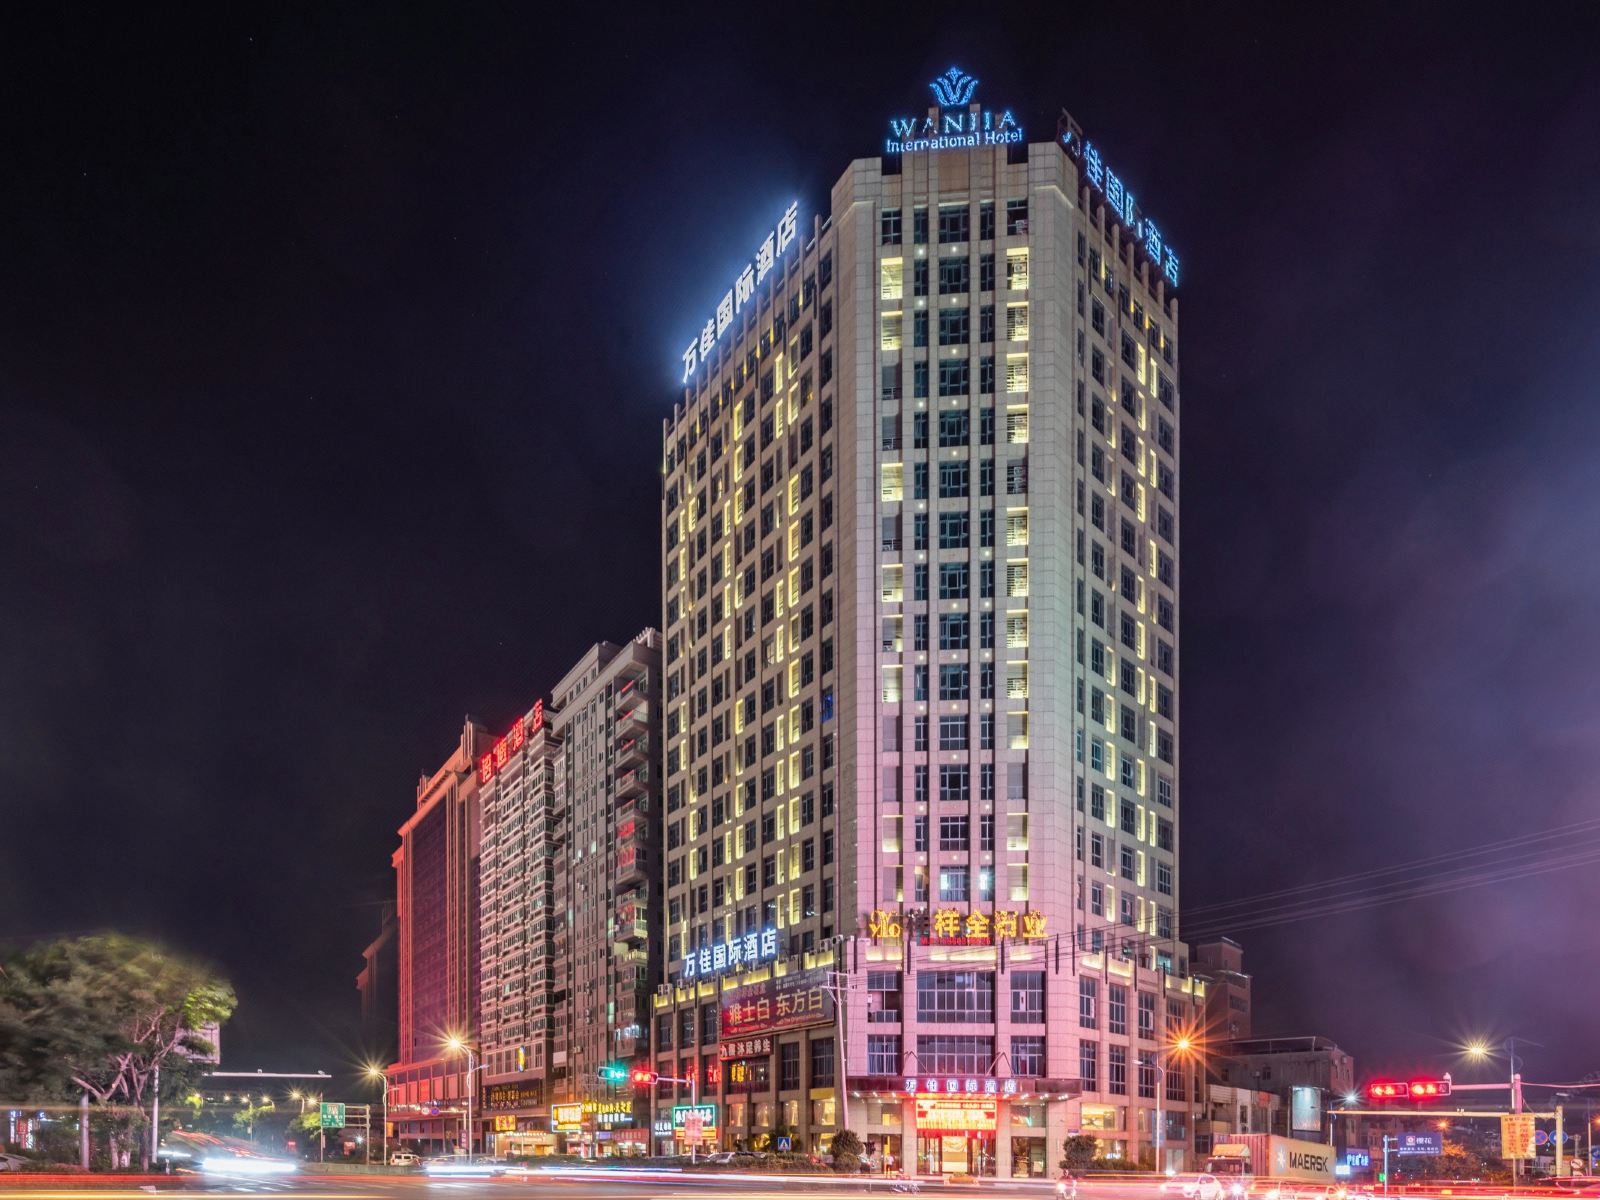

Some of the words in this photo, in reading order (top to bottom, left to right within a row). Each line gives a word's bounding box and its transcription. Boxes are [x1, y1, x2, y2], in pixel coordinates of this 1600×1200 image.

[887, 132, 980, 153] International
[985, 128, 1023, 145] Hotel
[682, 200, 798, 383] 万佳国际酒店
[684, 928, 777, 977] 万佳国际酒店
[729, 997, 770, 1026] 雅士白
[776, 987, 823, 1017] 东方白
[1290, 1152, 1328, 1172] MAERSK
